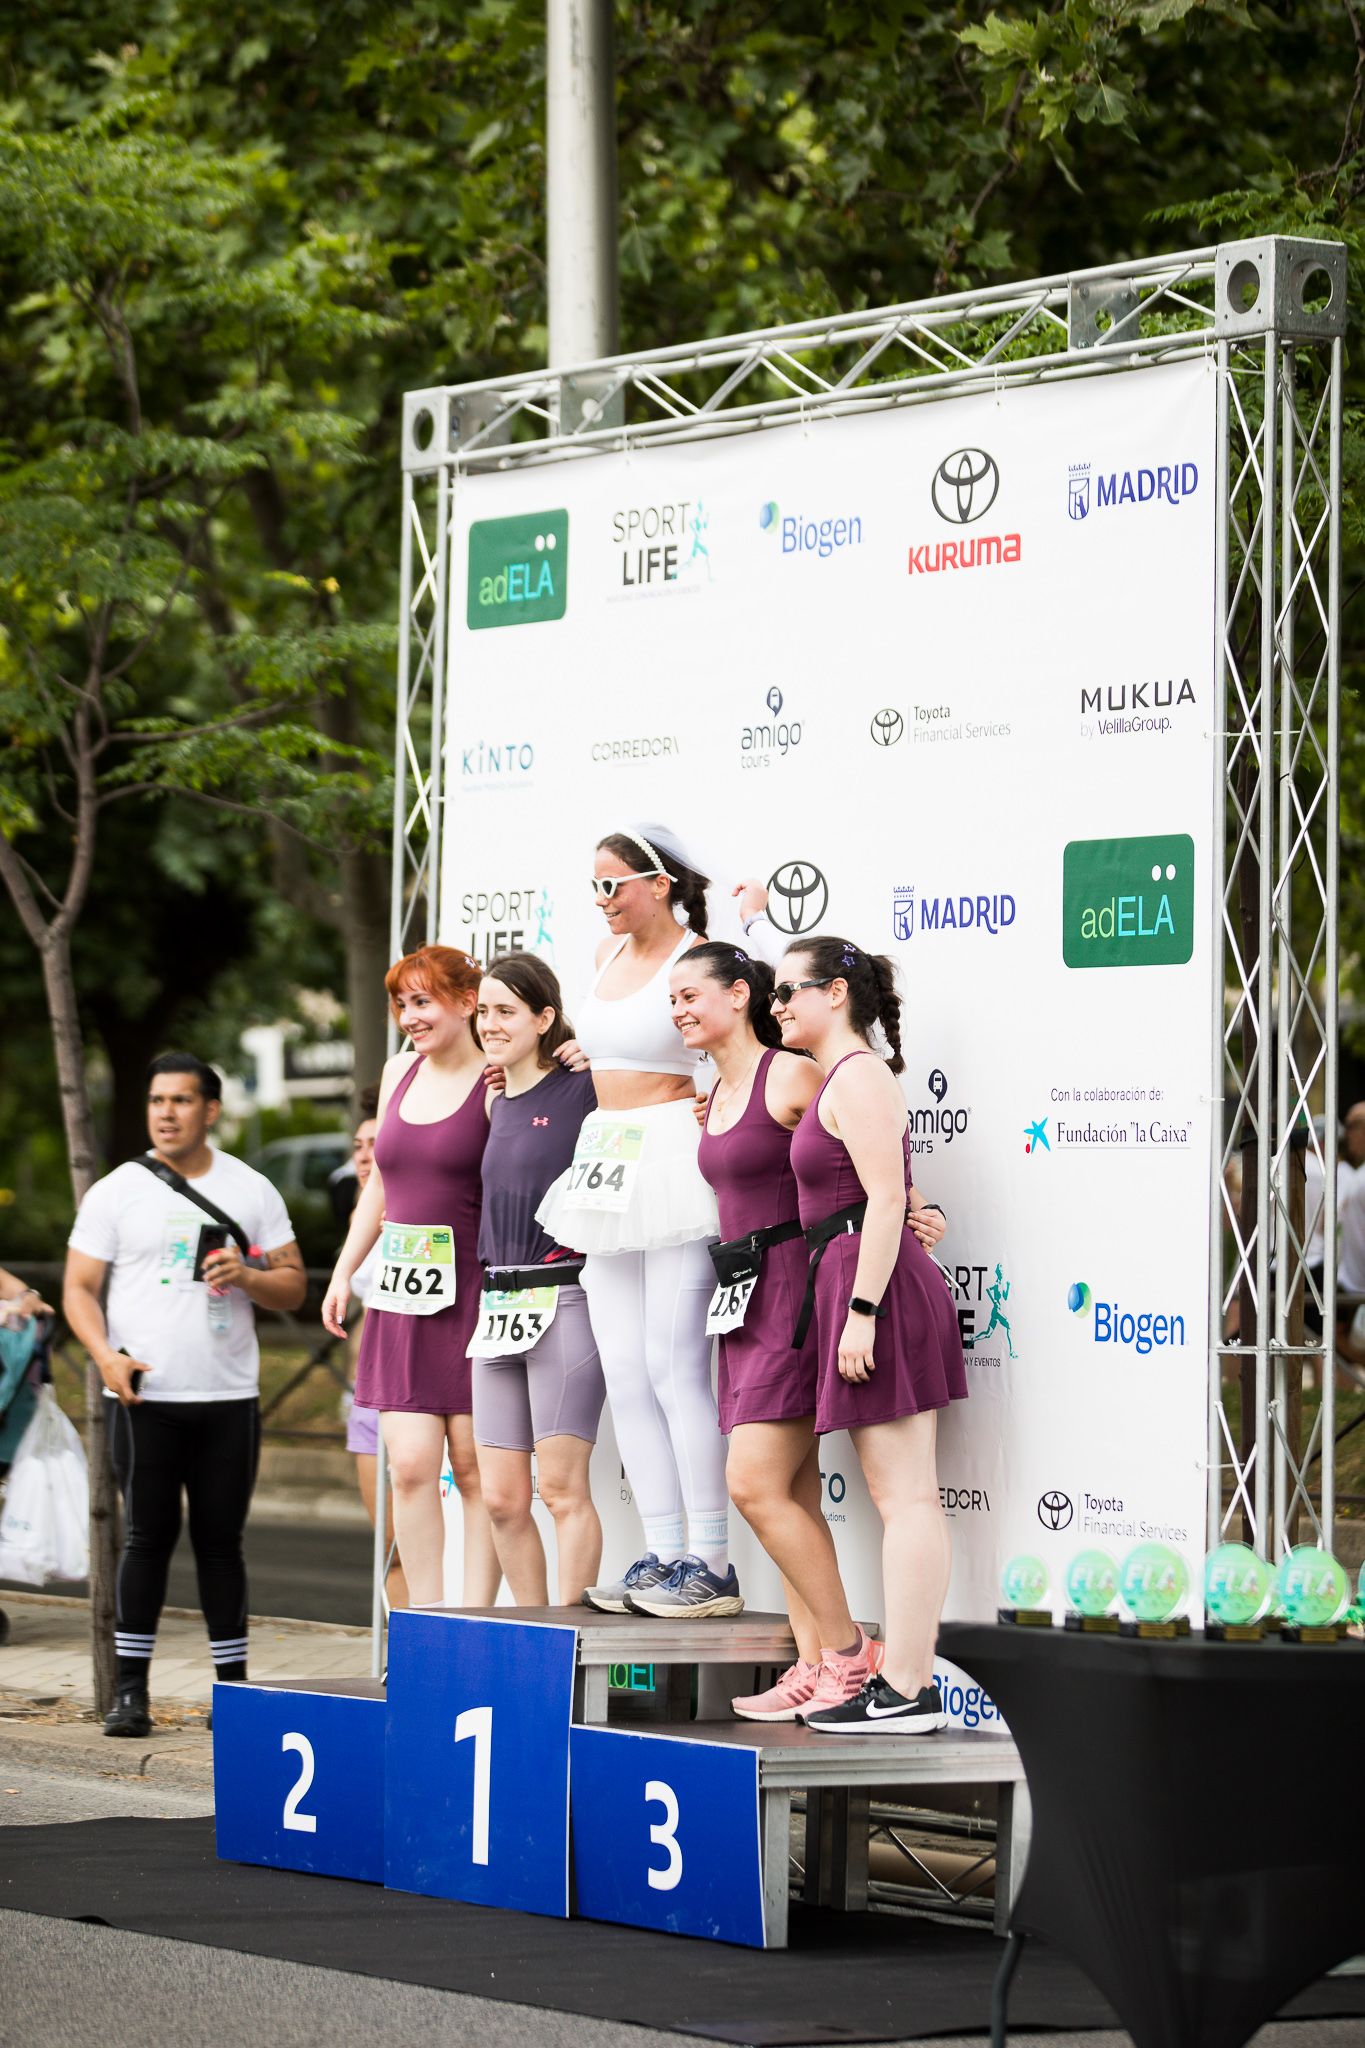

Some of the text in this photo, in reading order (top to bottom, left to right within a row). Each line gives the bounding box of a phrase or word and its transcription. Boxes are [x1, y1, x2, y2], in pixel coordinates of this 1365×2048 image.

[1098, 462, 1198, 507] MADRID
[613, 503, 690, 543] SPORT
[782, 516, 861, 557] Biogen
[623, 545, 678, 585] LIFE
[479, 559, 554, 605] adELA
[1082, 678, 1196, 713] MUKUA
[914, 705, 950, 723] Toyota
[741, 721, 800, 754] amigo
[914, 722, 1011, 743] Financial Services
[741, 754, 770, 769] tours
[462, 890, 535, 924] SPORT
[921, 894, 1016, 935] MADRID
[1081, 894, 1175, 938] adELA
[1051, 1087, 1163, 1101] Con la colaboración de:
[909, 1140, 933, 1153] ours
[1057, 1122, 1127, 1142] Fundación
[566, 1162, 625, 1191] 1764
[380, 1265, 443, 1295] 1762
[482, 1313, 543, 1341] 1763
[1094, 1302, 1185, 1354] Biogen
[975, 1358, 1000, 1367] EVENTOS
[826, 1511, 846, 1522] utions
[1085, 1494, 1123, 1514] Toyota
[1084, 1517, 1187, 1541] Financial Services
[281, 1732, 316, 1833] 2
[455, 1706, 493, 1866] 1
[644, 1781, 683, 1891] 3
